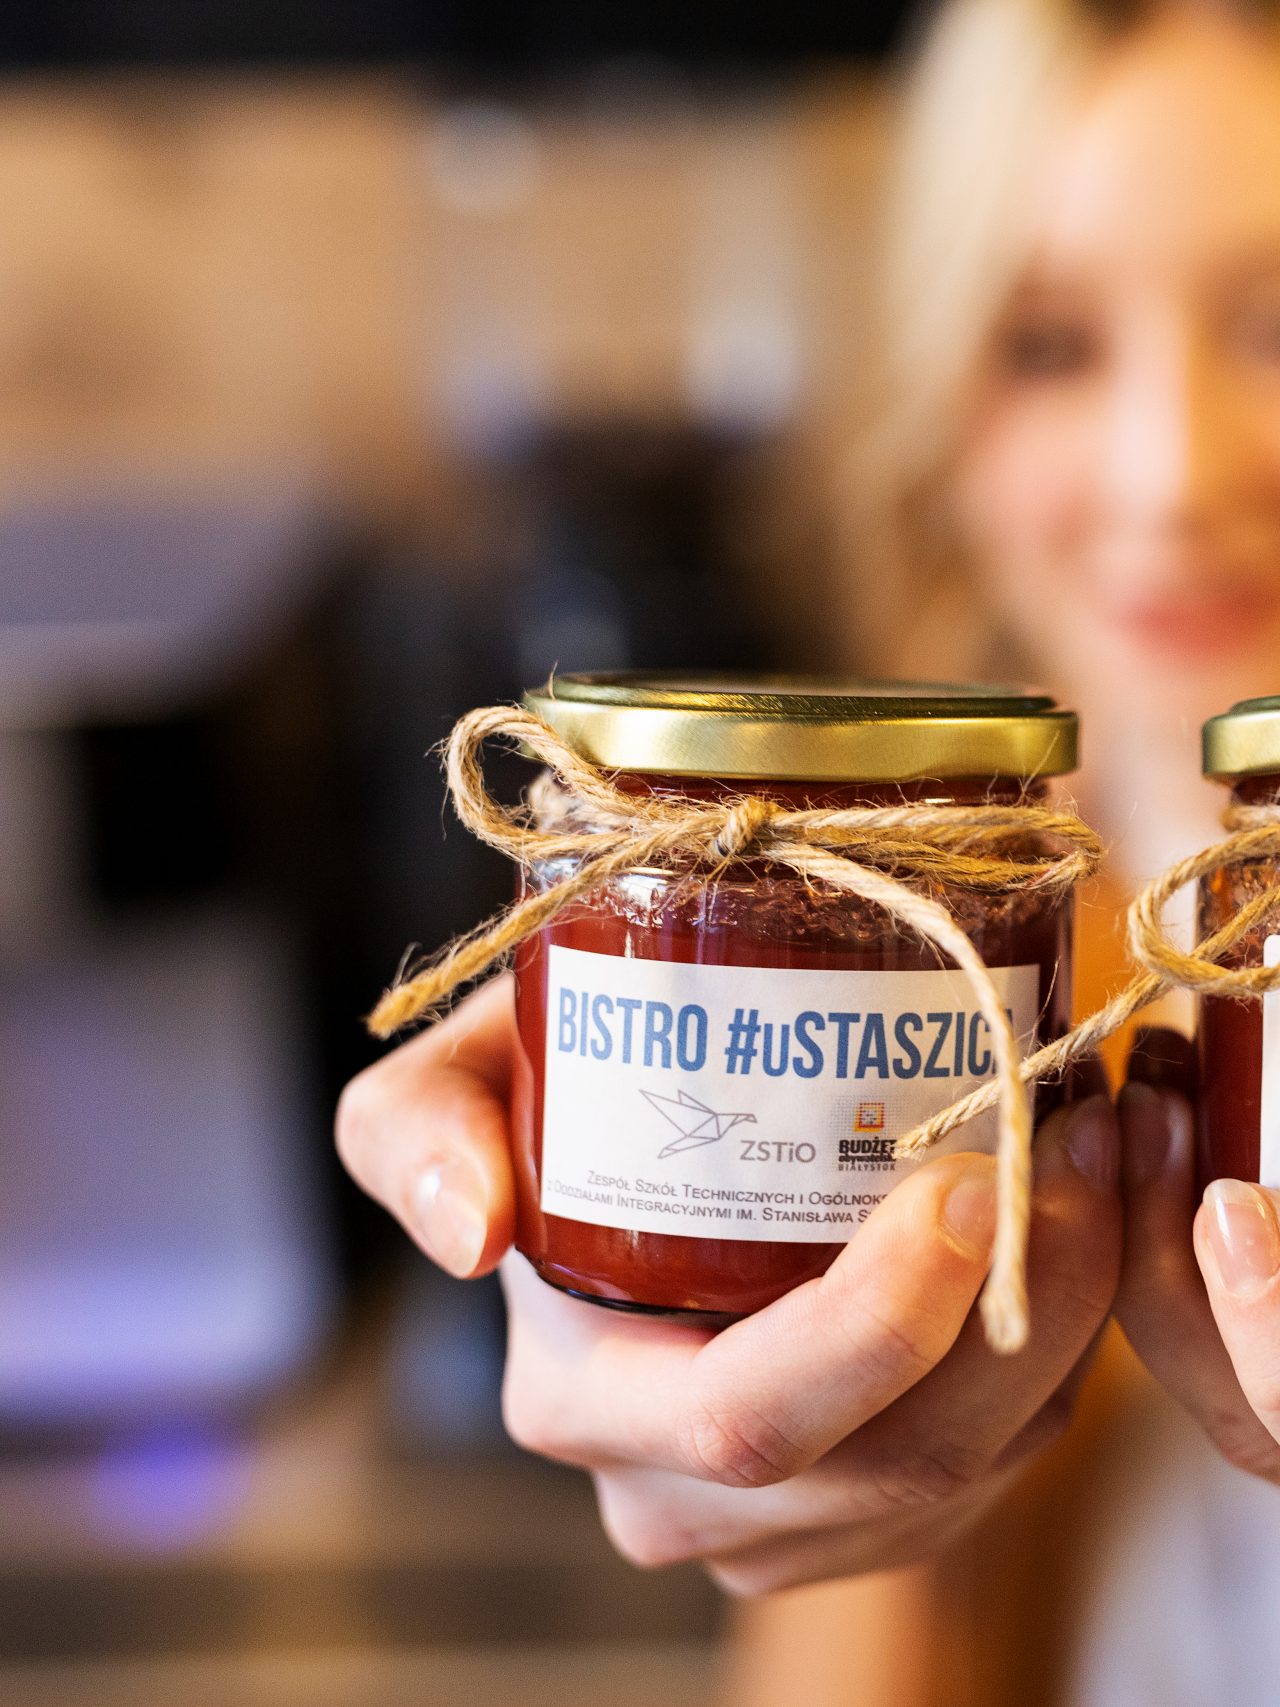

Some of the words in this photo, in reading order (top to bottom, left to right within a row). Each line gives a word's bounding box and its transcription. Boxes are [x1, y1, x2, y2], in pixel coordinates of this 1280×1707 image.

[558, 986, 709, 1072] BISTRO
[725, 1007, 1012, 1080] #uSTASZIC
[739, 1139, 817, 1164] ZSTiO
[617, 1192, 732, 1221] INTEGRACYJNYMI
[762, 1207, 854, 1223] STANISŁAWA
[682, 1183, 795, 1205] TECHNICZNYCH
